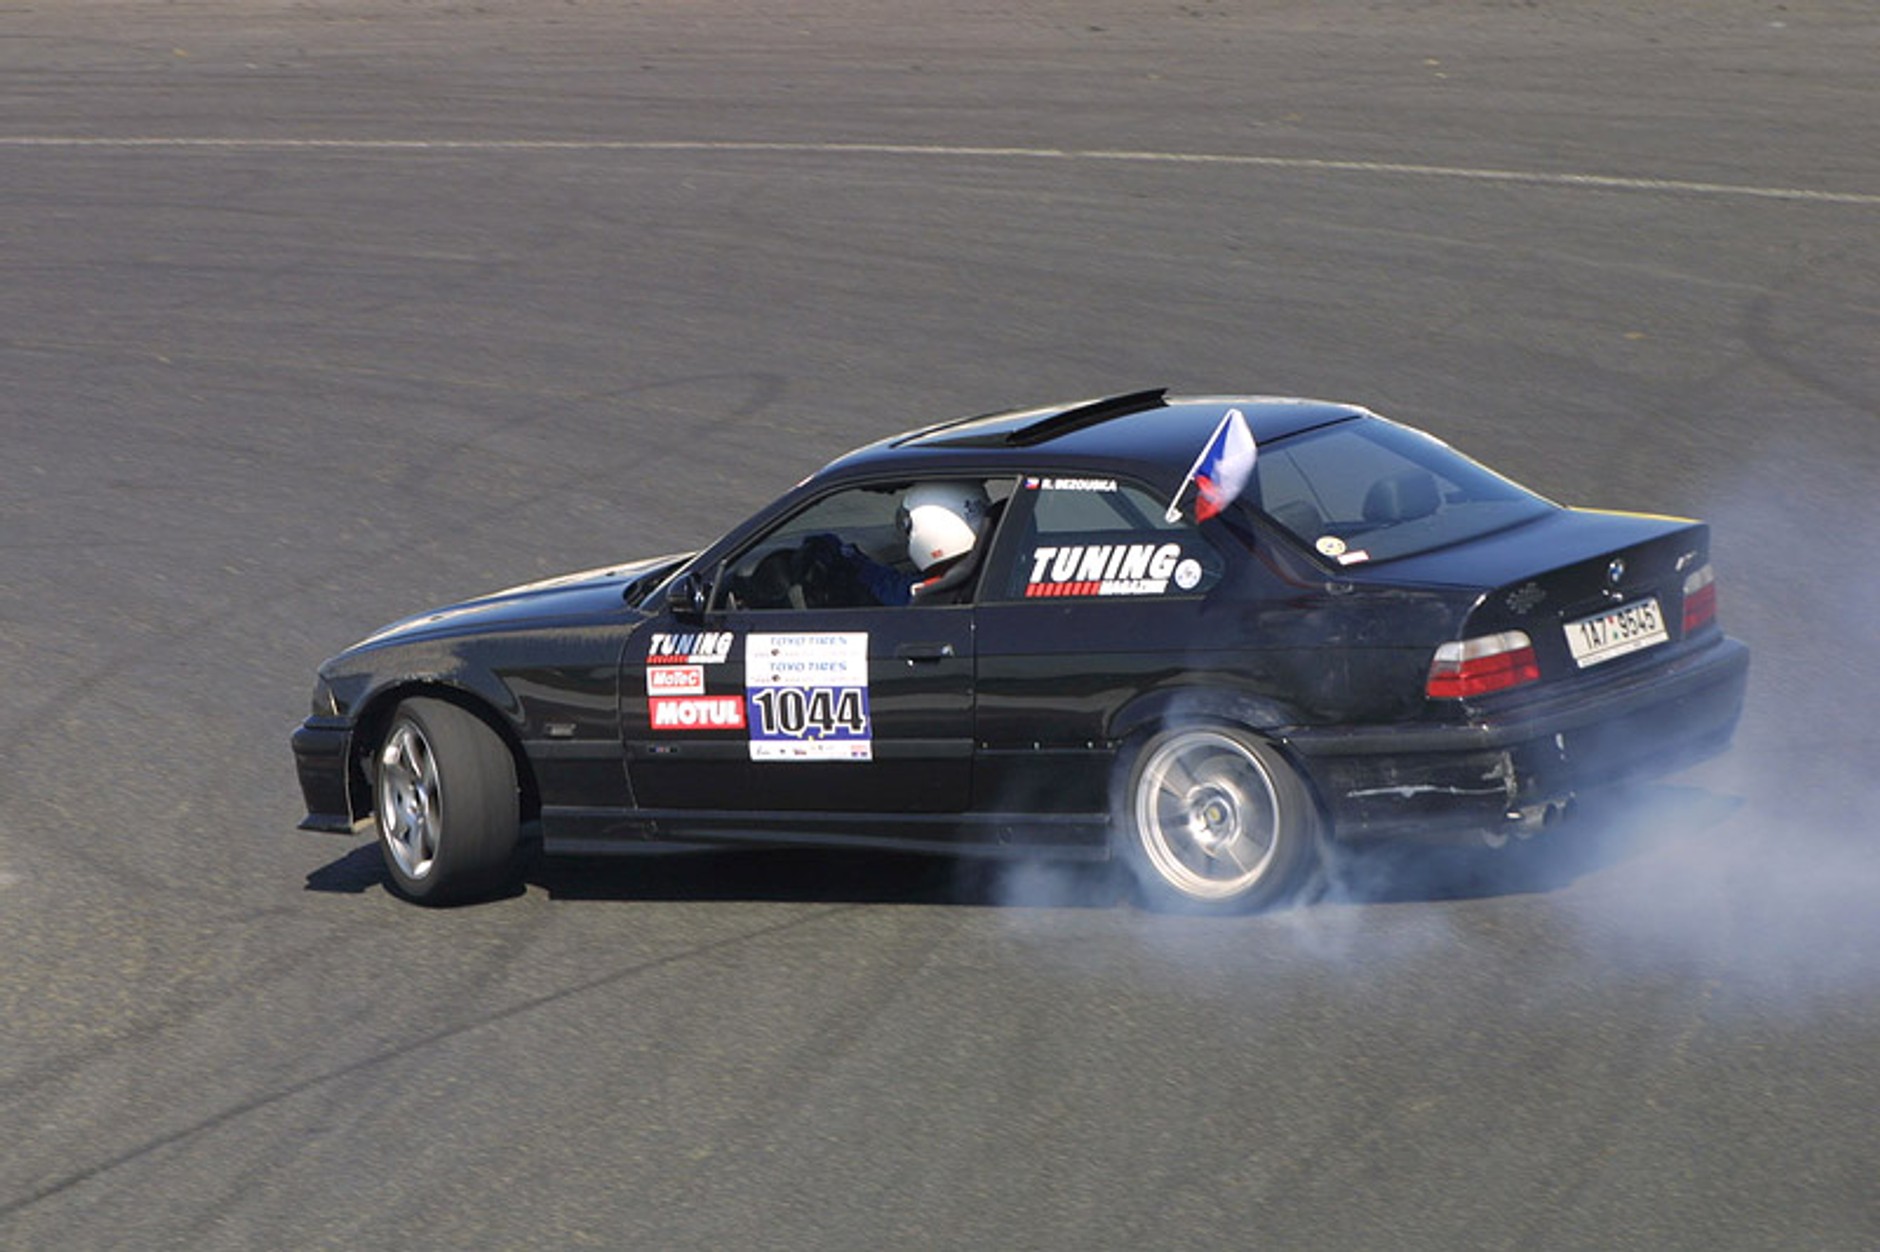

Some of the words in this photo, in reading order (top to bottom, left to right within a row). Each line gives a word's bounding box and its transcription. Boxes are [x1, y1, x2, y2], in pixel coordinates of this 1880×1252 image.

[1030, 542, 1181, 582] TUNING
[649, 632, 734, 655] TUNING
[770, 661, 805, 672] TOYO
[655, 700, 741, 725] MOTUL
[752, 687, 867, 736] 1044
